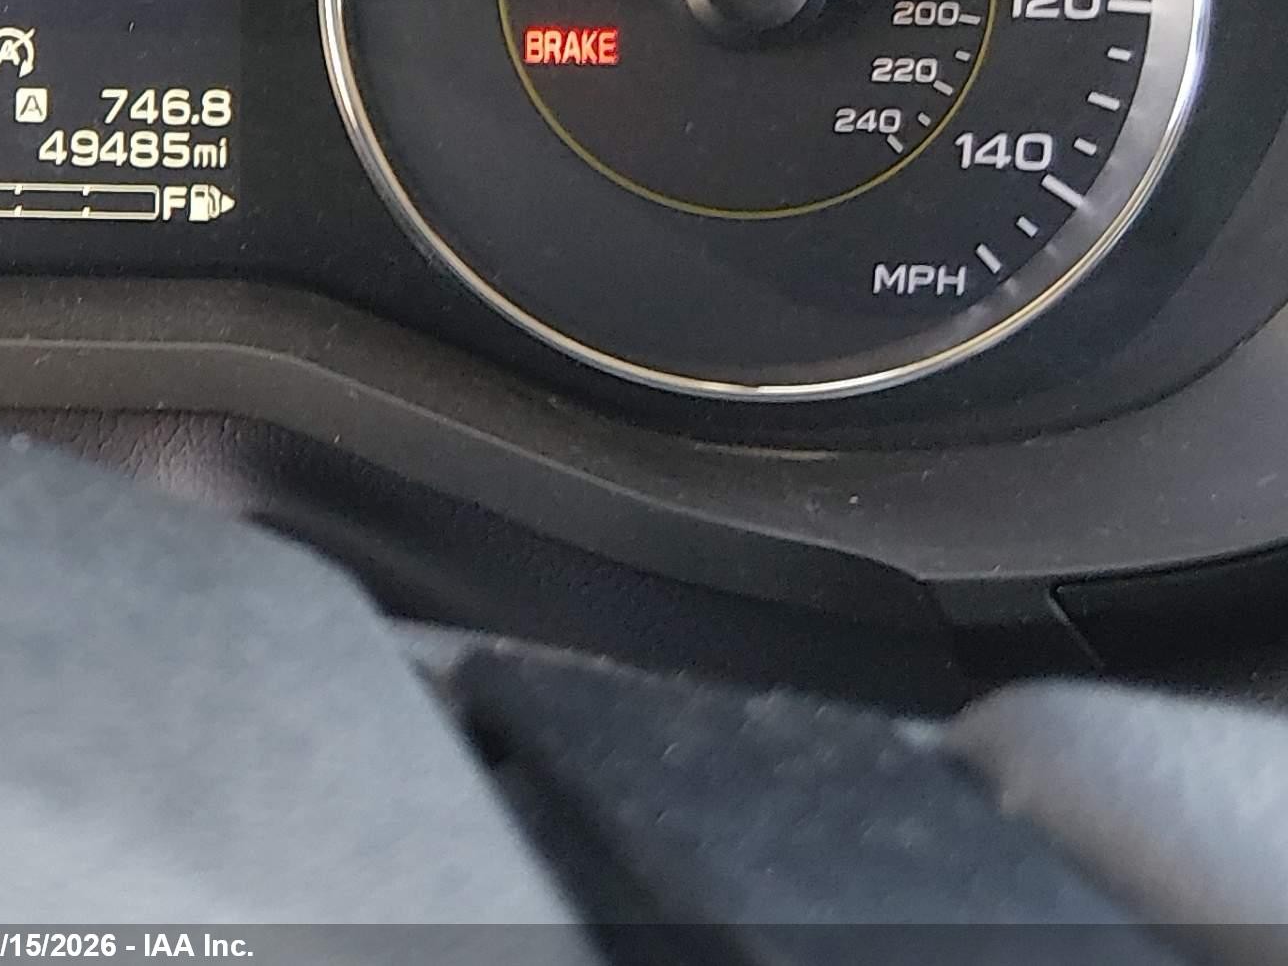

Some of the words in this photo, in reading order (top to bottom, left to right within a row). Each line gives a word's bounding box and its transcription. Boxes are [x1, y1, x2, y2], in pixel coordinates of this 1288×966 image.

[893, 1, 959, 27] 200
[526, 31, 618, 64] BRAKE
[871, 58, 937, 83] 220
[20, 92, 42, 117] A
[101, 89, 231, 126] 746.8
[835, 109, 901, 134] 240
[39, 130, 227, 168] 49485mi
[955, 133, 1052, 171] 140
[163, 187, 187, 220] F
[873, 264, 966, 295] MPH
